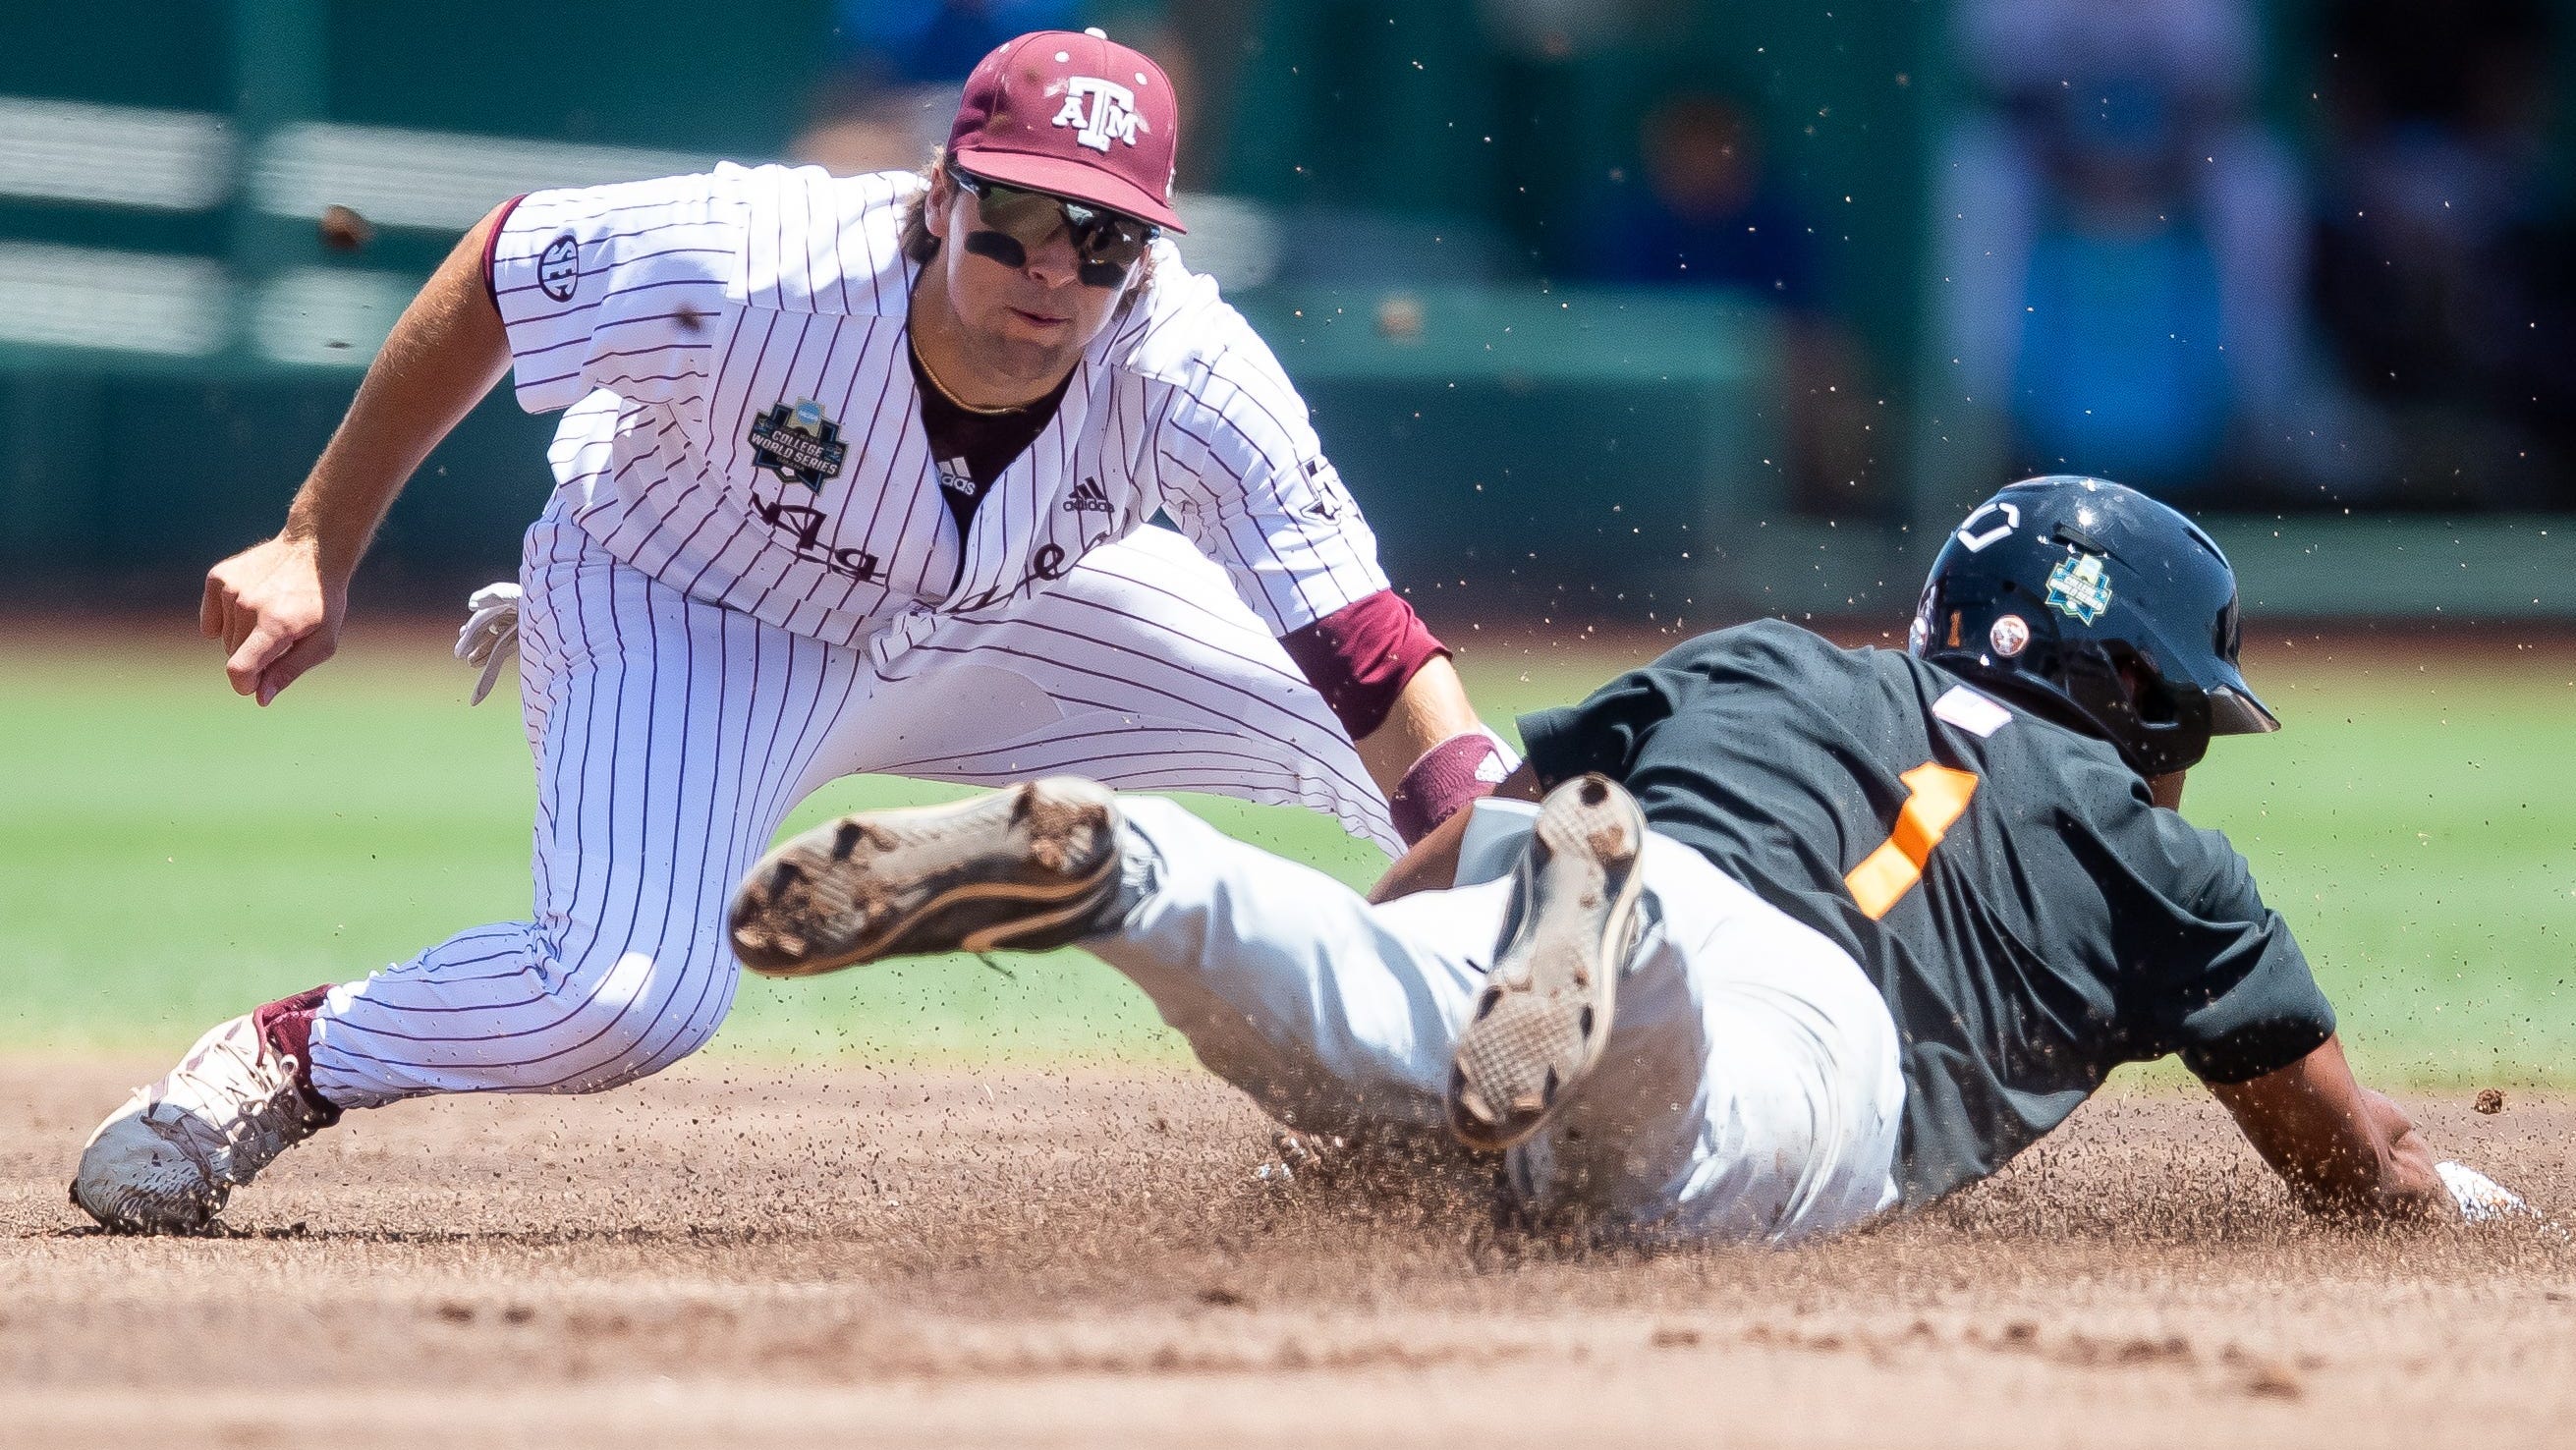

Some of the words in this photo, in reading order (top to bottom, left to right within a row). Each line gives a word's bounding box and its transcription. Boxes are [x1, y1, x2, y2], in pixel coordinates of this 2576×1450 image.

[540, 235, 577, 299] SEC
[751, 433, 794, 459] WORLD
[793, 452, 838, 474] SERIES
[771, 430, 825, 458] COLLEGE
[1063, 496, 1115, 514] adidas
[1947, 610, 1961, 647] 1
[1844, 761, 1980, 922] 1
